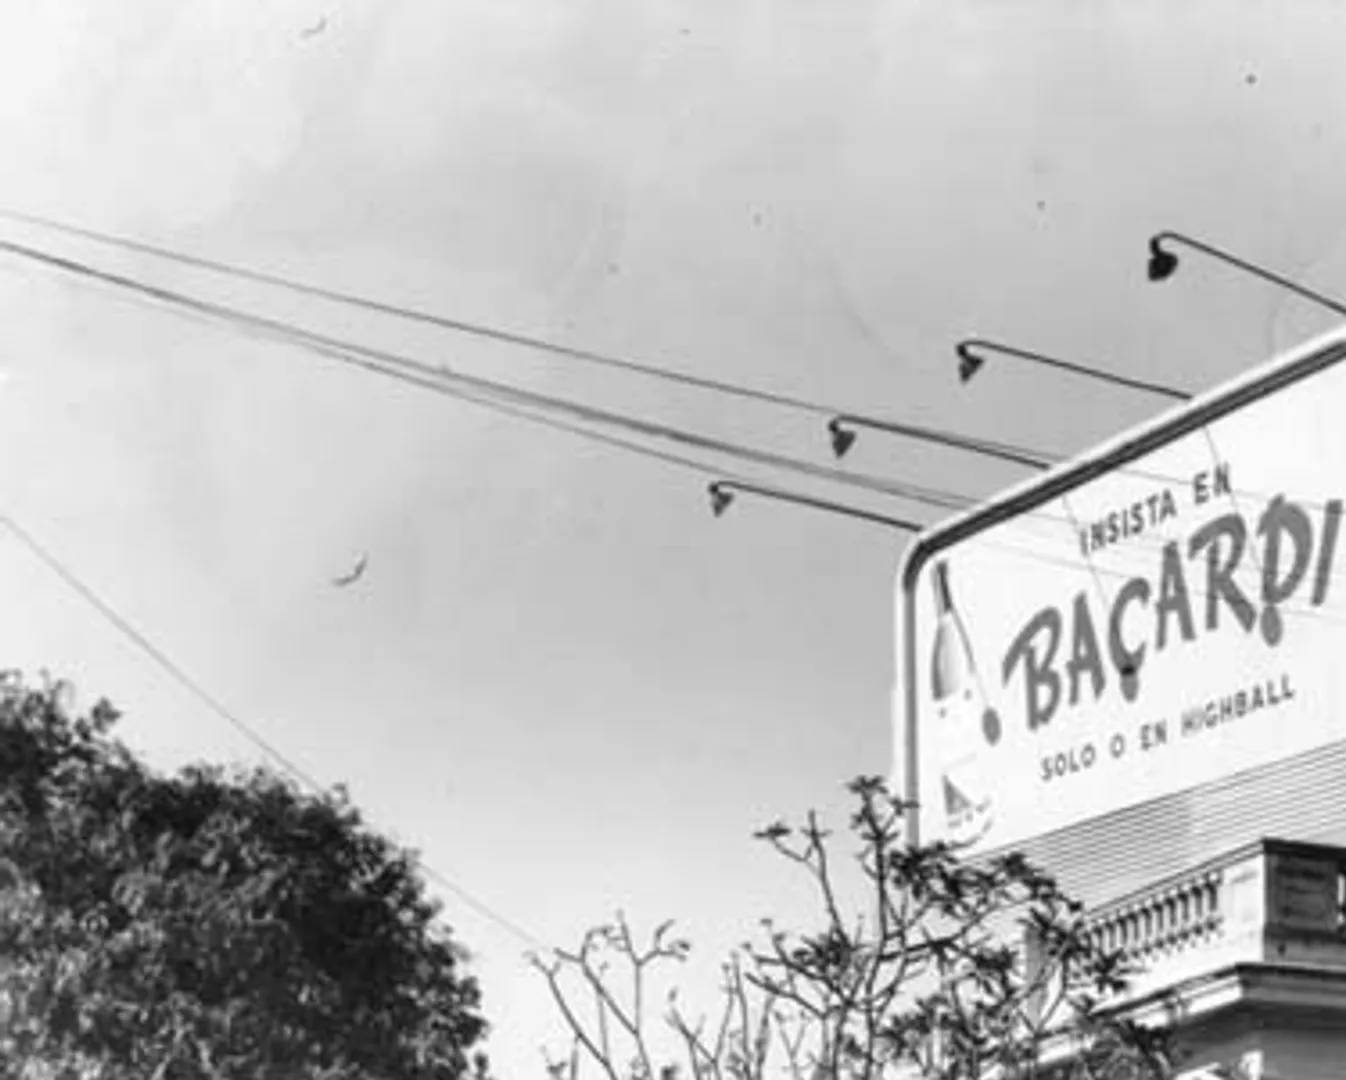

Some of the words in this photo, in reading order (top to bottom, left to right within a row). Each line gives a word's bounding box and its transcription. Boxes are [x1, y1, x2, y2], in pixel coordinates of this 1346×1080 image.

[1079, 489, 1178, 556] INSISTA
[1193, 462, 1231, 505] EN
[1003, 496, 1344, 731] BACARDI
[1041, 745, 1096, 782] SOLO
[1110, 734, 1126, 759] O
[1140, 719, 1168, 751] EN
[1182, 676, 1296, 733] HIGHBALL
